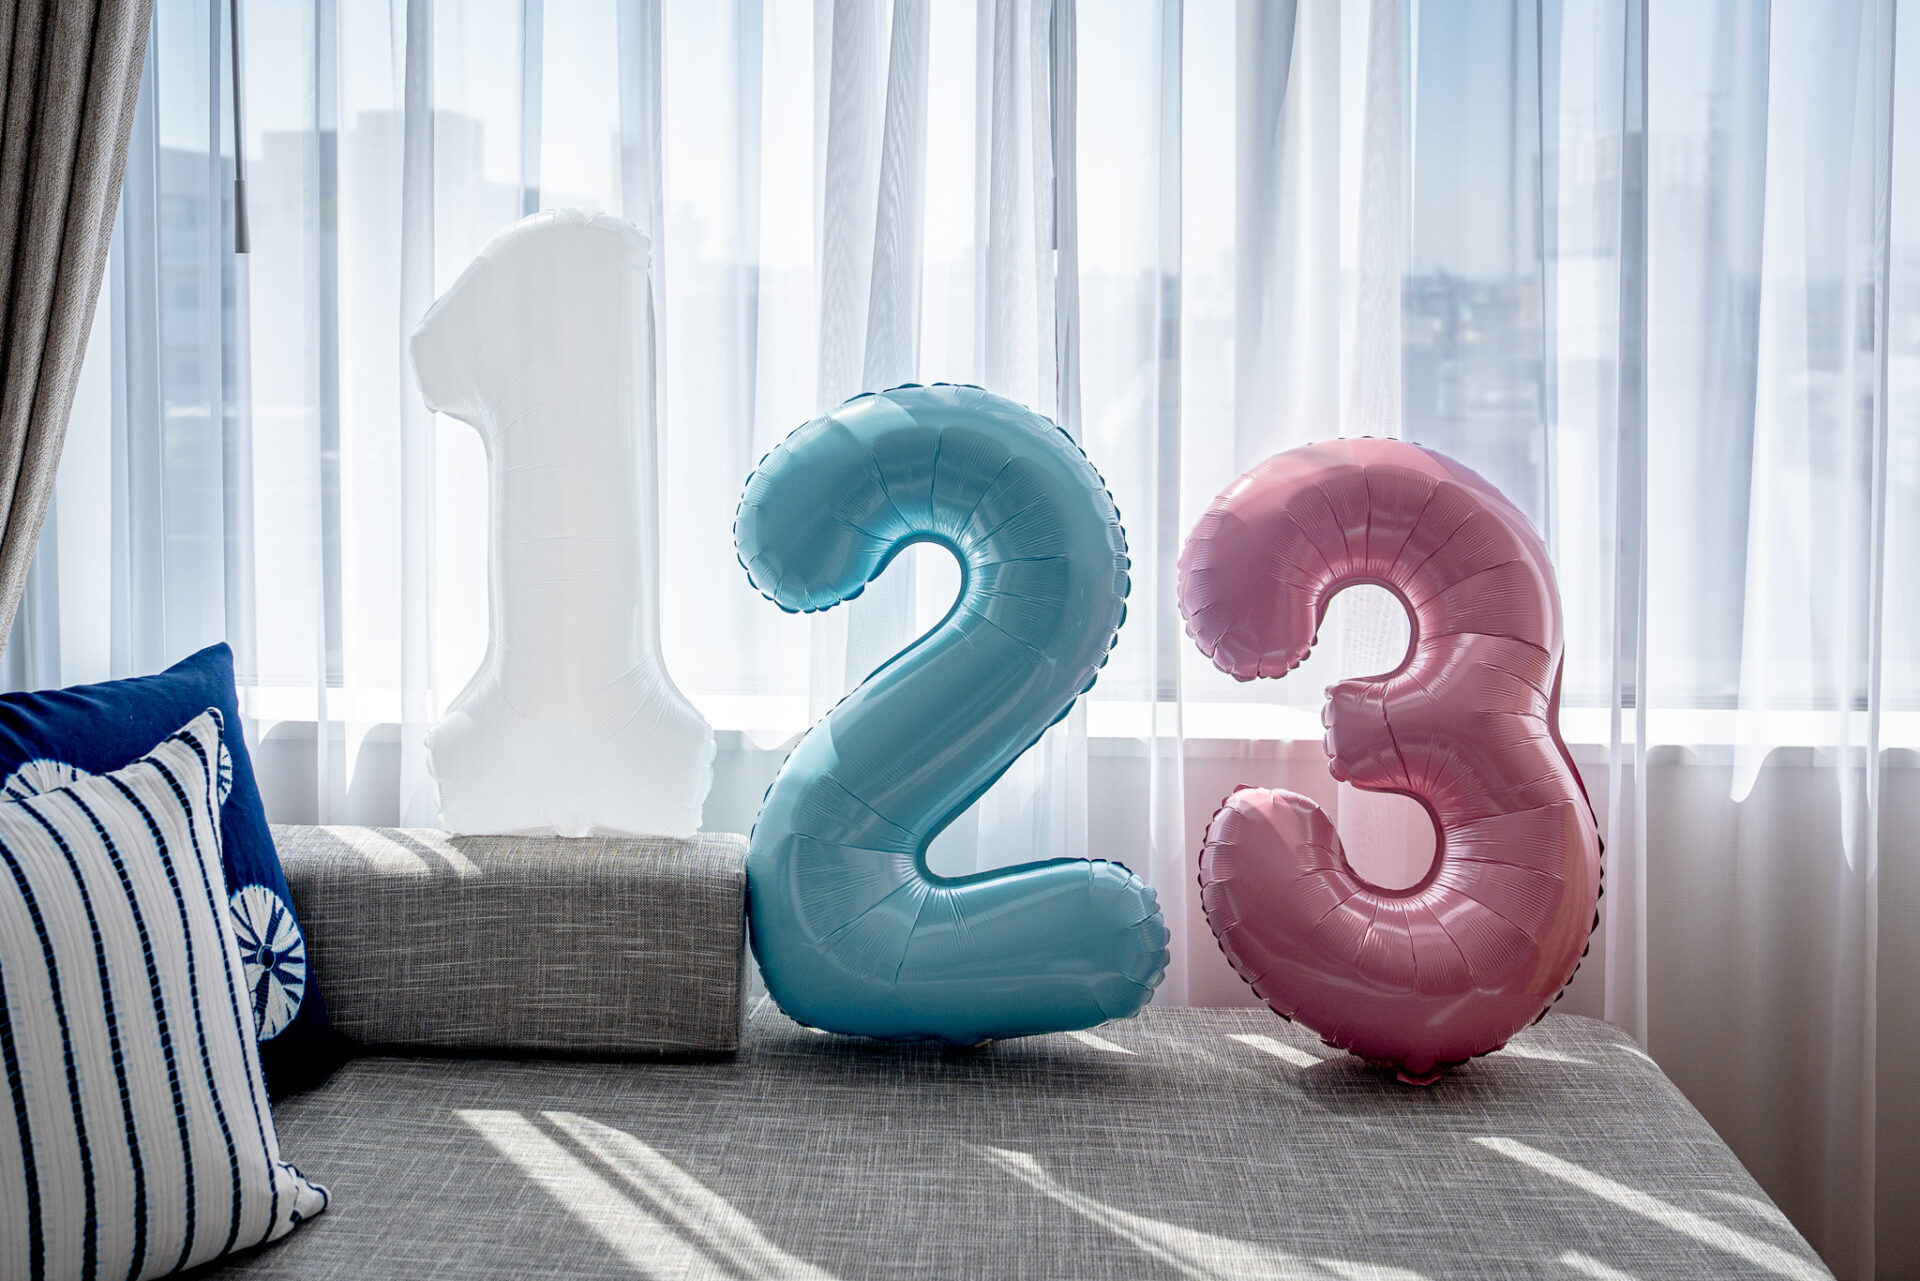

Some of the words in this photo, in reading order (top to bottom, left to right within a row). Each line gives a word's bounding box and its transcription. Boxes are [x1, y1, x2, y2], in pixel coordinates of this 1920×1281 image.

[410, 207, 717, 839] 1
[734, 382, 1171, 1044] 2
[1177, 436, 1606, 1085] 3
